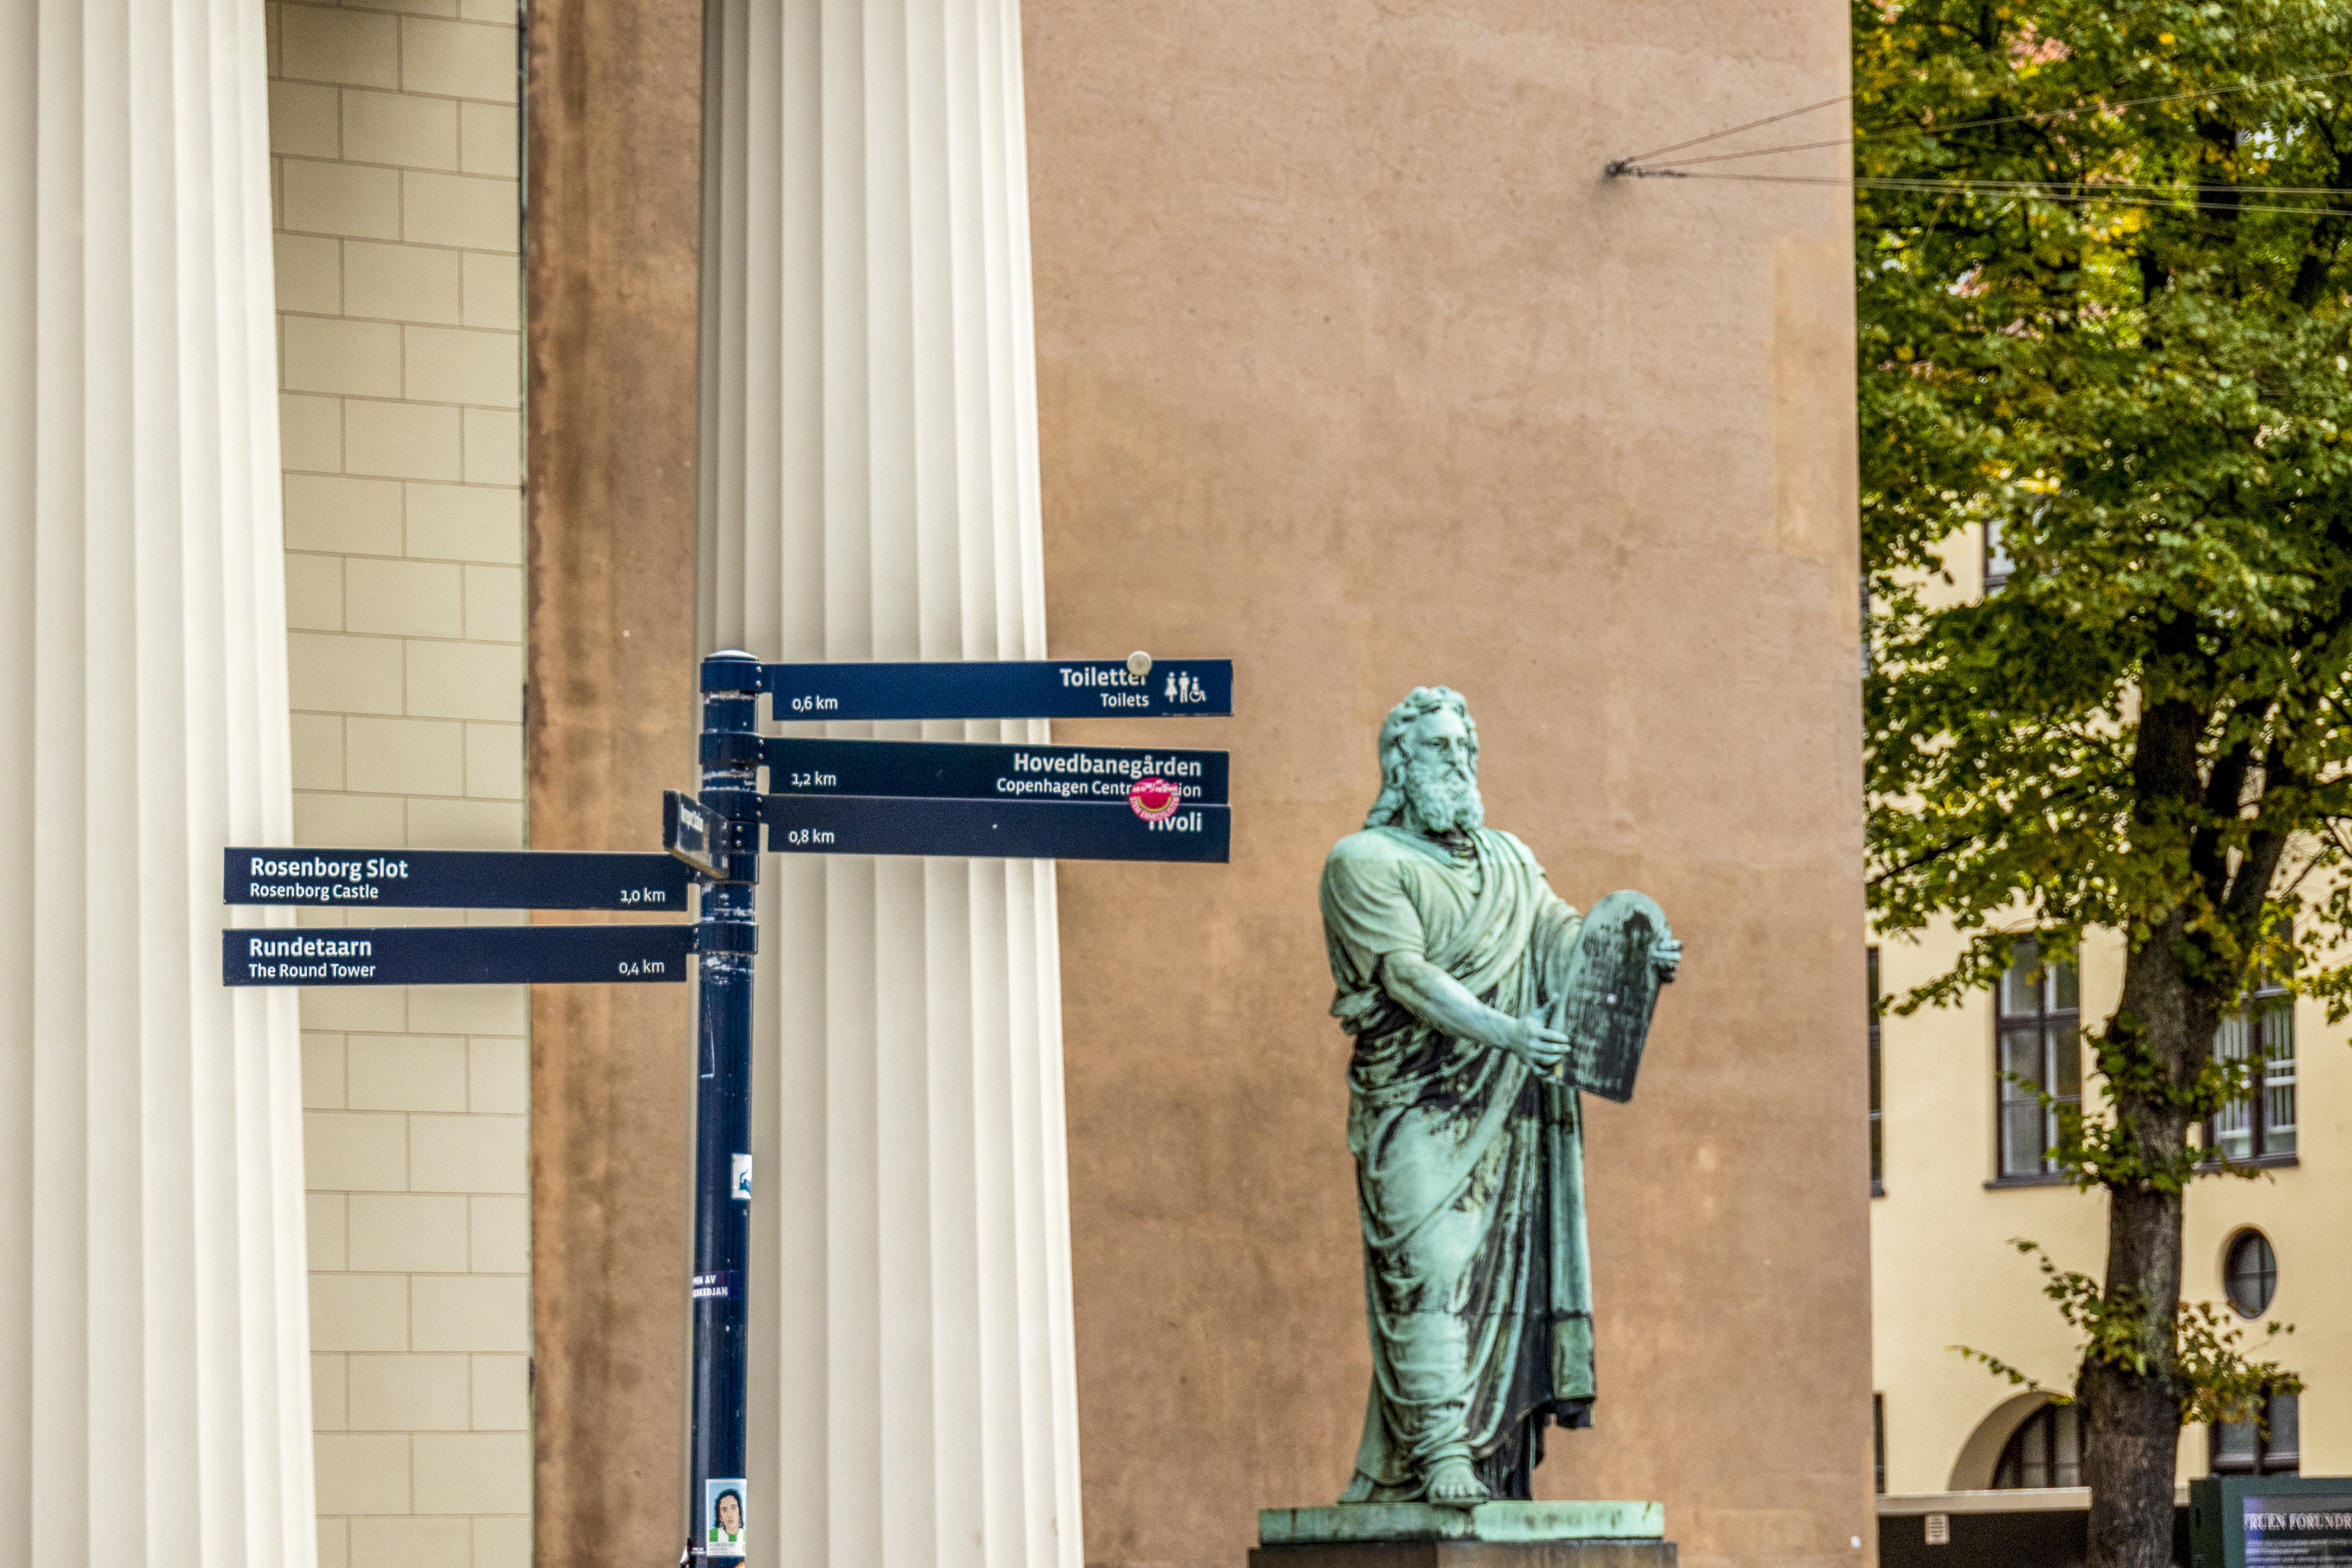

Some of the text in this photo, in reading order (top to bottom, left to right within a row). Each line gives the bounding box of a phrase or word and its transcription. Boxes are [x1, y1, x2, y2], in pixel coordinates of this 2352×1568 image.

[792, 695, 838, 713] 0,6 km
[1100, 692, 1149, 707] Toilets
[1014, 753, 1201, 779] Hovedbanegården
[792, 771, 837, 789] 1,2 km
[996, 777, 1088, 797] Copenhagen
[789, 828, 834, 846] 0,8 km
[250, 857, 408, 882] Rosenborg Slot
[250, 883, 379, 902] Rosenborg Castle
[620, 887, 666, 905] 1,0 km
[249, 937, 372, 957] Rundetaarn
[249, 962, 376, 978] The Round Tower
[619, 958, 665, 977] 0,4 km
[705, 1275, 717, 1284] AV
